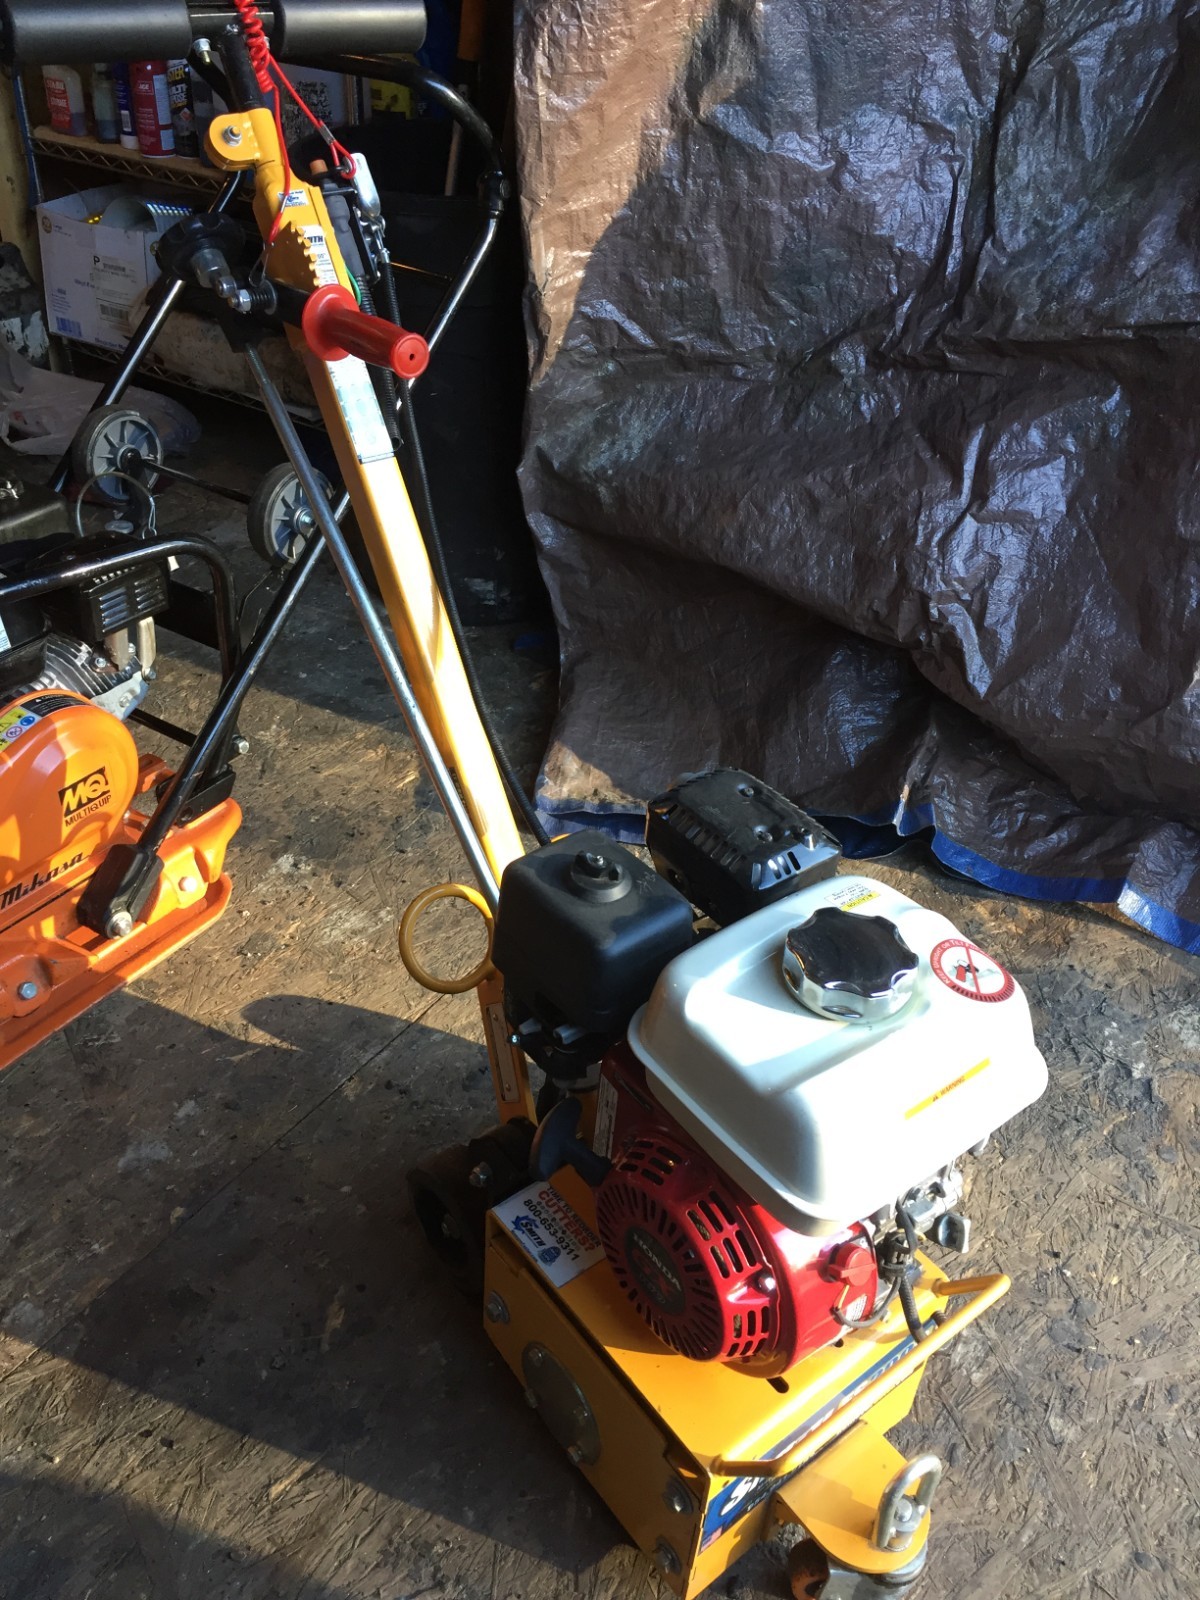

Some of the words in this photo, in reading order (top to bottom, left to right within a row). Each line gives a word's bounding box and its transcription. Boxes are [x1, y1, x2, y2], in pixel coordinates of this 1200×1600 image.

[65, 794, 112, 828] MULTIQUIP
[0, 851, 85, 909] Mikasa
[523, 1198, 580, 1262] 800-653-9311
[537, 1189, 596, 1252] CUTTERS?
[560, 1201, 572, 1215] TO
[633, 1233, 682, 1292] HONDA
